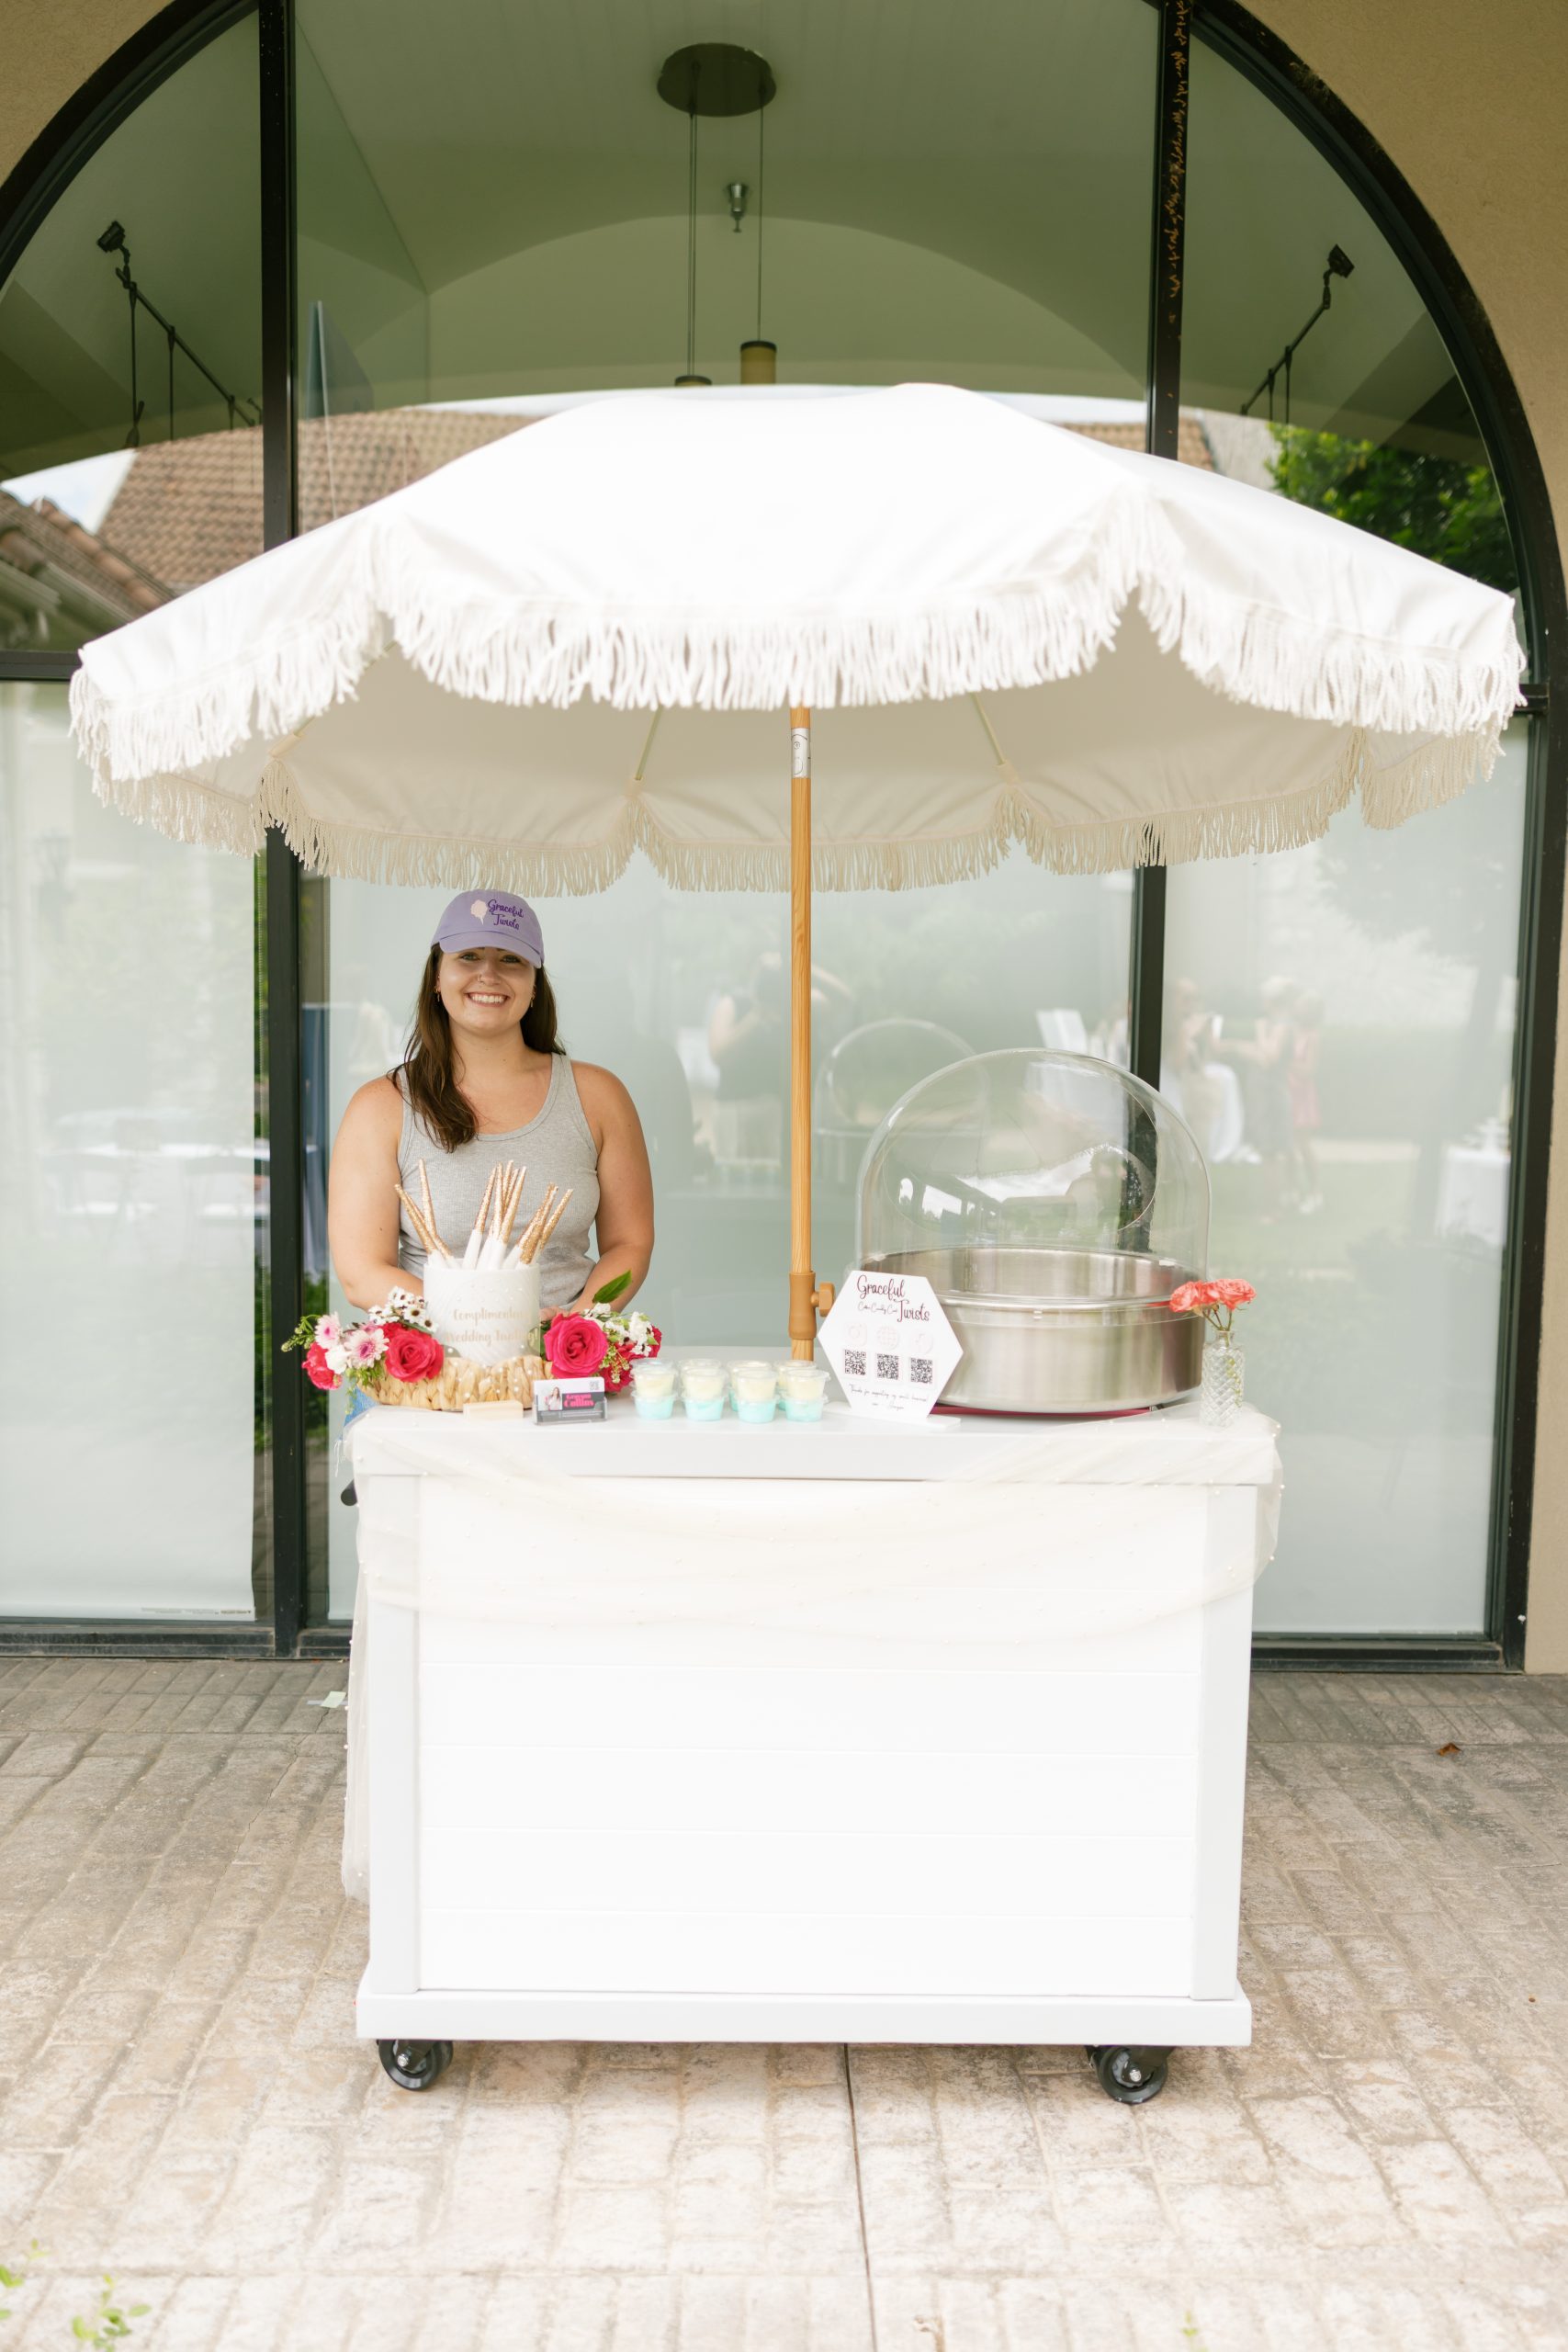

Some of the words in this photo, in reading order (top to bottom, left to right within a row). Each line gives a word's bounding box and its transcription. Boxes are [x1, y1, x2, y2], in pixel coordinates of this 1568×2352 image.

[488, 899, 524, 918] Graceful
[857, 1274, 905, 1300] Graceful
[454, 1306, 528, 1327] Complimenta
[893, 1298, 931, 1322] Twists
